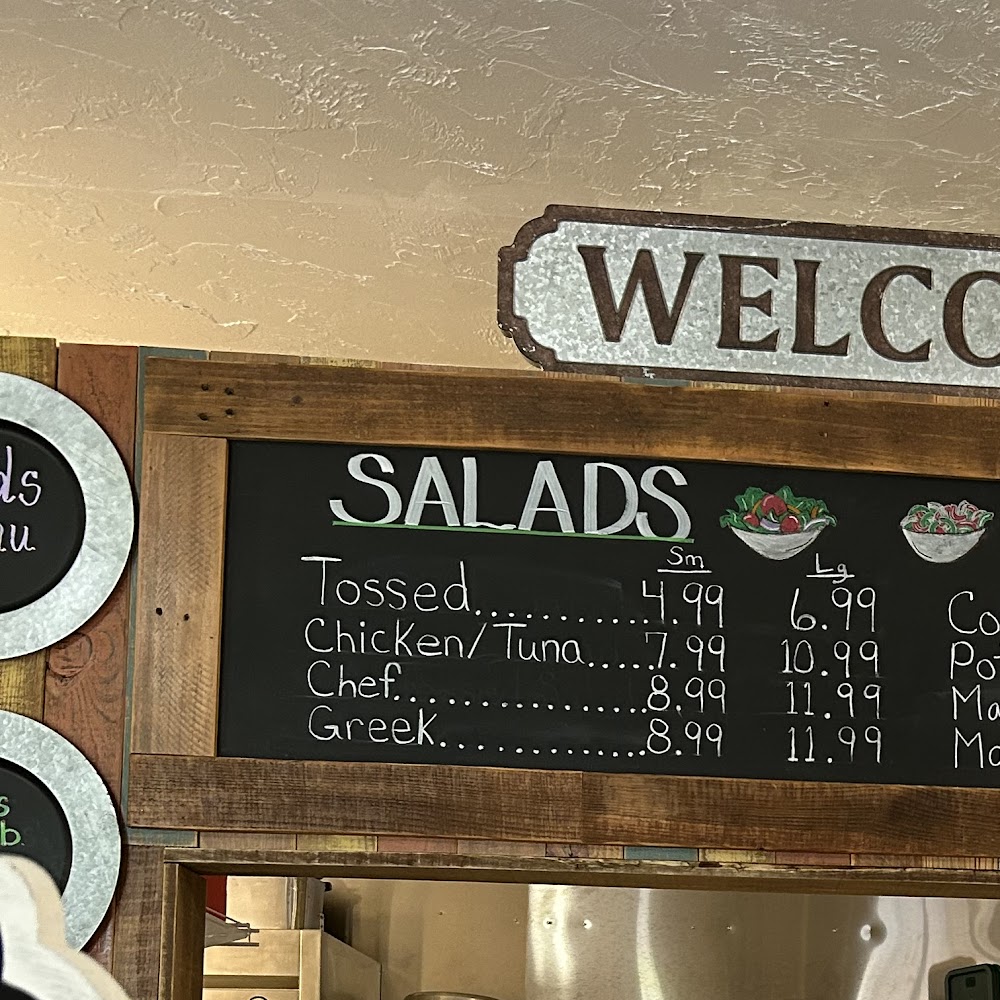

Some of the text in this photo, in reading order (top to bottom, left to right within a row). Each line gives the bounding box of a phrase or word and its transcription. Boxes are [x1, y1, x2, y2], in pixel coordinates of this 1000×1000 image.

[329, 453, 692, 538] SALADS
[666, 545, 705, 569] Sm
[815, 552, 848, 584] Lg
[300, 556, 876, 633] Tossed 4.99 6.99
[304, 617, 880, 678] Chicken/ Tuna 7.99 10.99
[306, 660, 882, 720] Chef 8.99 11.99
[307, 705, 882, 763] Greek 8.99 11.99
